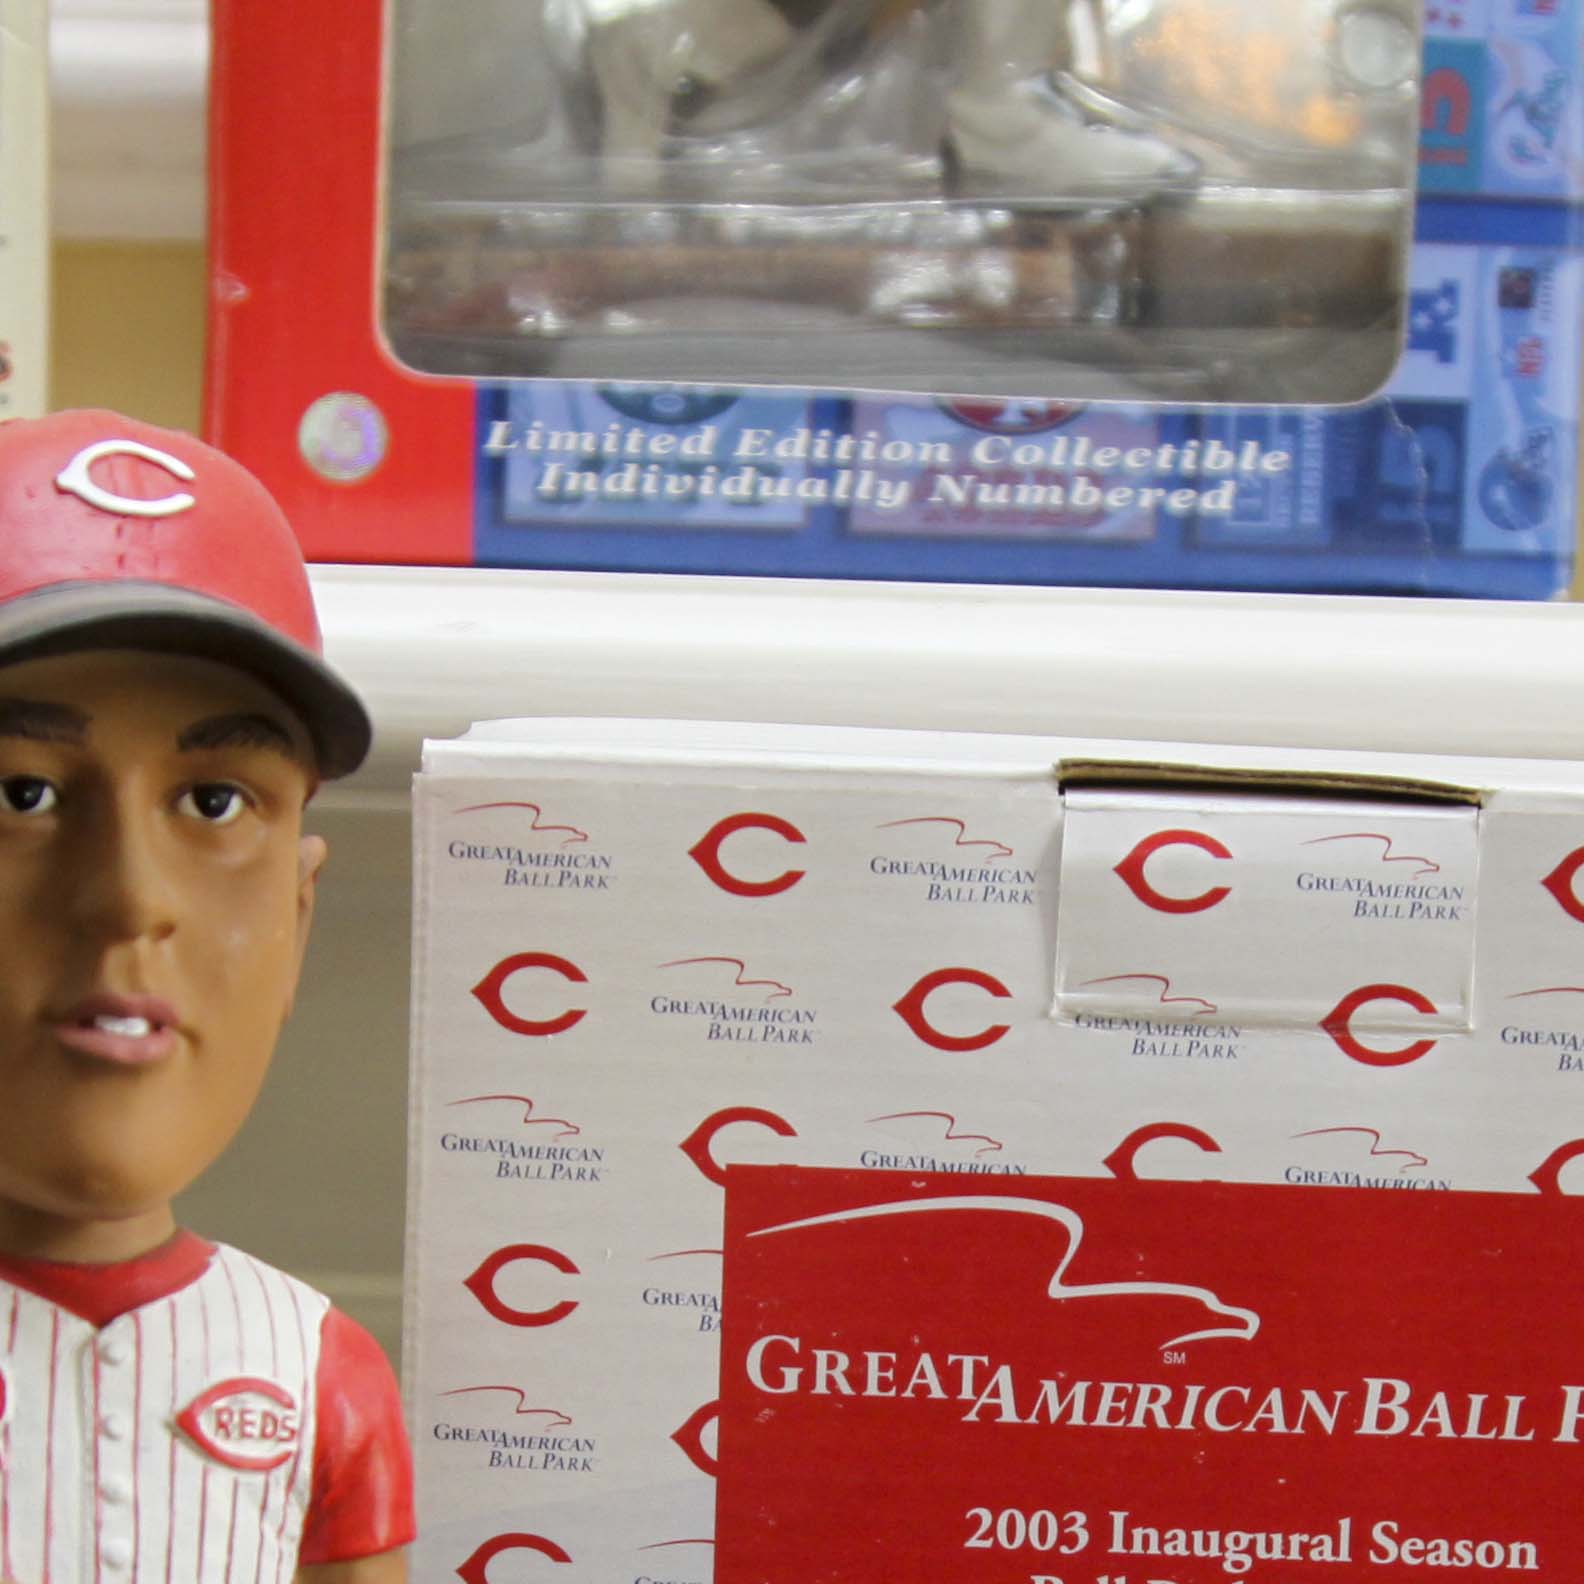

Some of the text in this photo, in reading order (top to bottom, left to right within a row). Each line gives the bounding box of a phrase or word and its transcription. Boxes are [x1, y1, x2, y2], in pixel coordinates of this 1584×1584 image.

[483, 420, 1291, 473] Limited Edition Collectible
[54, 438, 196, 517] C
[537, 462, 911, 508] Individually
[927, 474, 1237, 512] Numbered
[504, 869, 608, 889] BALL PARK
[927, 883, 1033, 905] BALL PARK
[1353, 900, 1460, 921] BALL PARK
[707, 1023, 813, 1044] BALL PARK
[1131, 1038, 1237, 1059] BALL PARK
[495, 1160, 600, 1182] BALL PARK
[1354, 1377, 1535, 1441] BALL
[215, 1405, 299, 1443] REDS
[488, 1450, 592, 1472] BALL PARK
[964, 1507, 1539, 1574] 2003 Inaugural Season
